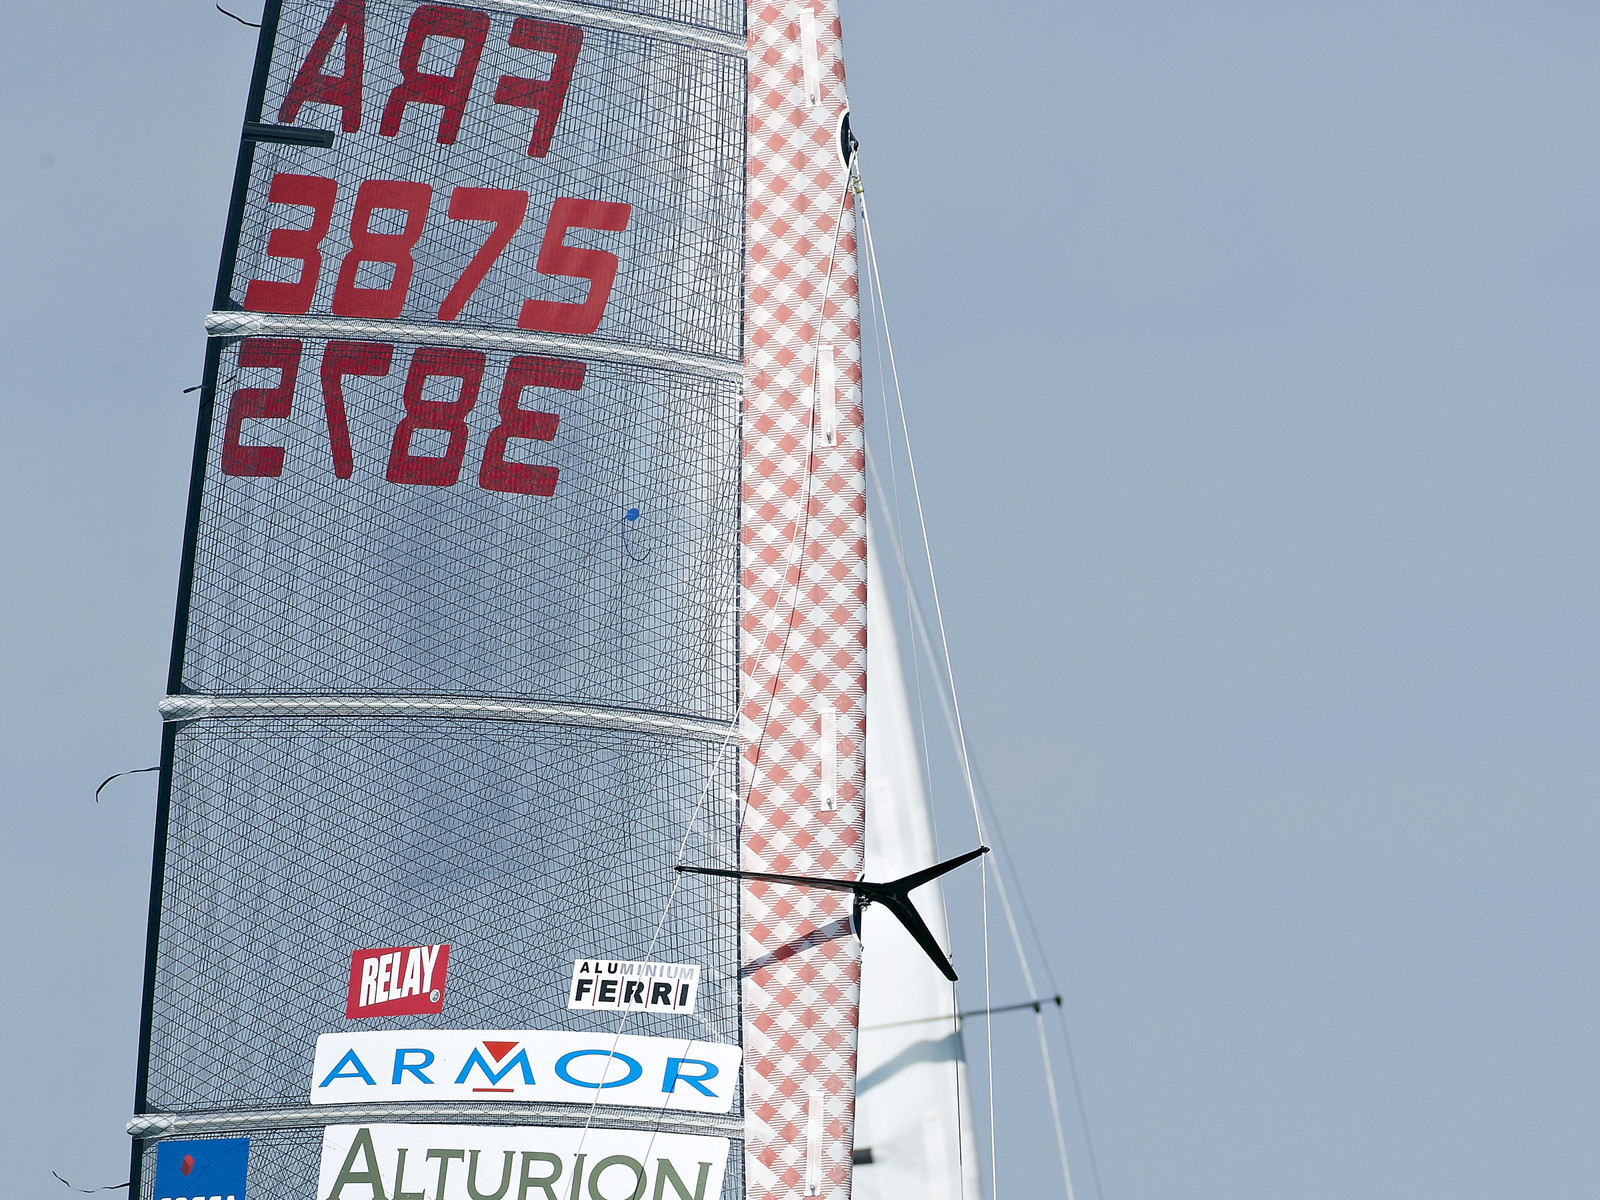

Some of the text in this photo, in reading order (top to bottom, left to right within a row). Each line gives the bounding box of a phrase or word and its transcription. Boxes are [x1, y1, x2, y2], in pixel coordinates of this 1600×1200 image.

[243, 173, 632, 335] 3875
[359, 945, 440, 1007] RELAY
[575, 979, 690, 1007] FERRI
[579, 961, 695, 980] ALUMINIUM
[318, 1046, 721, 1098] ARMOR
